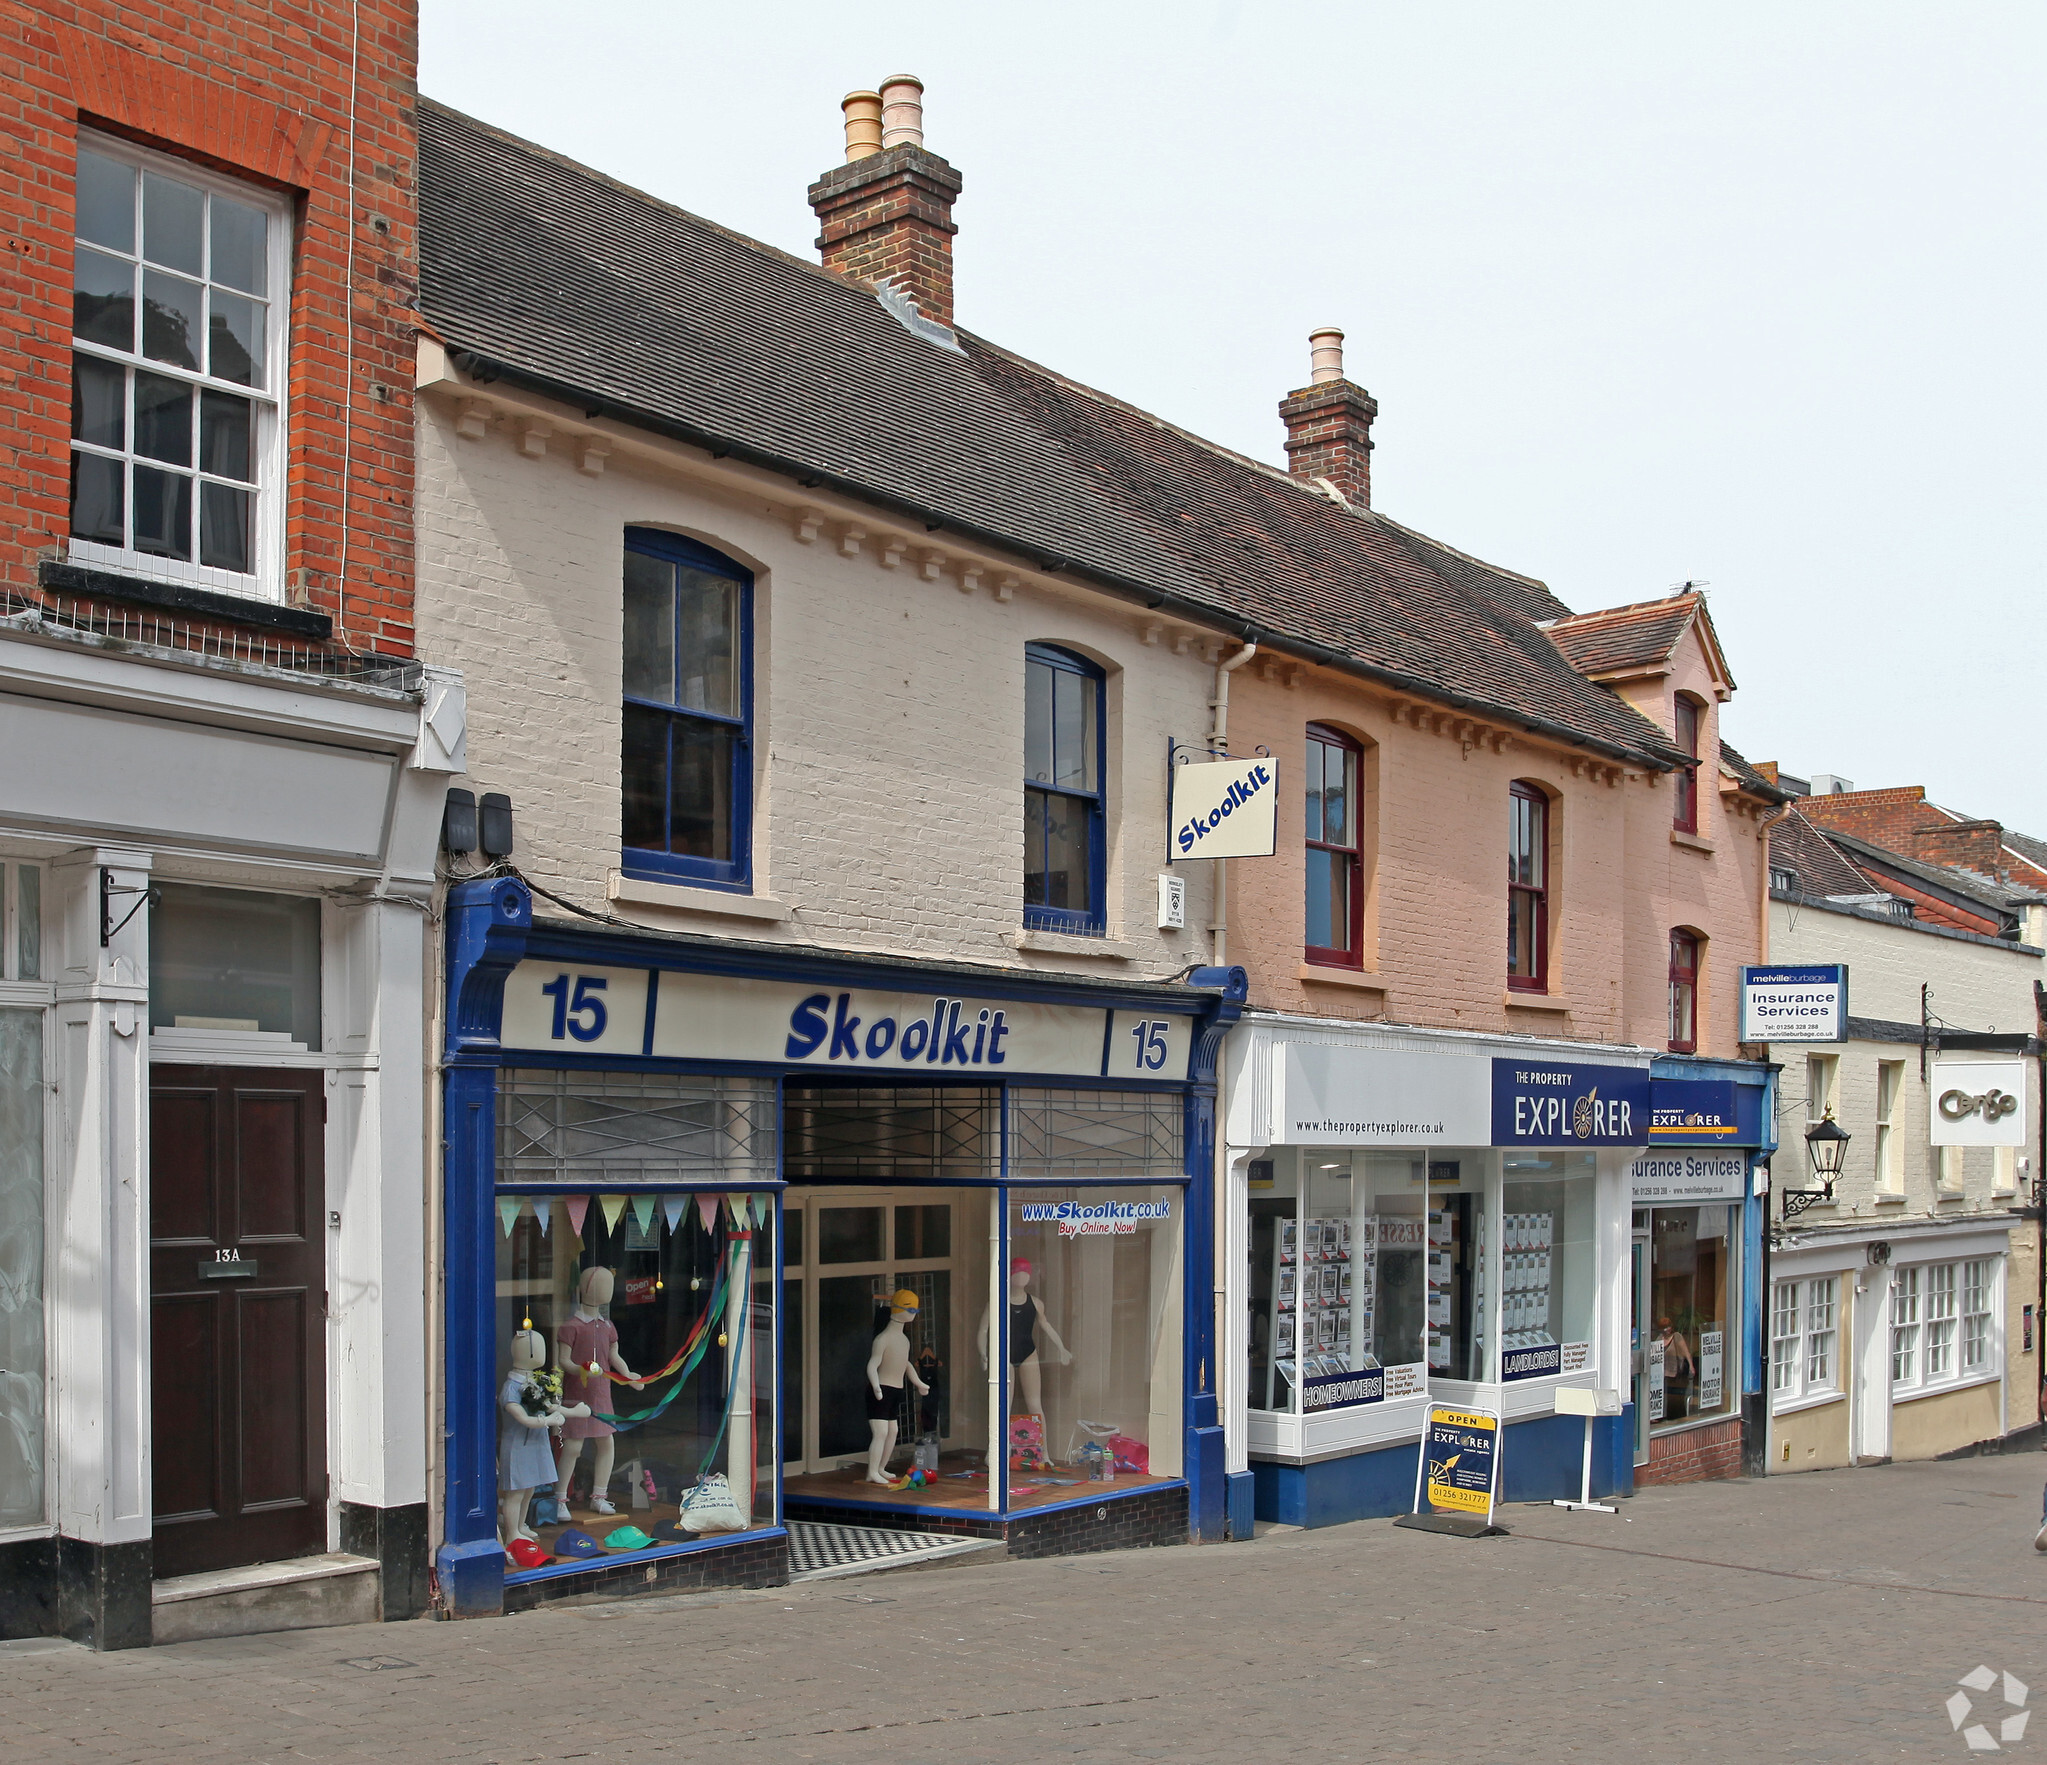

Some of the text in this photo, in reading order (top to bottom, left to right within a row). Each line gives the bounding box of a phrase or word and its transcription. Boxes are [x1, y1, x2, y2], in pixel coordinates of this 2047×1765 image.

[1178, 765, 1271, 853] Skoolkit
[1752, 974, 1827, 983] melvilleburbage
[1752, 993, 1835, 1003] Insurance
[542, 973, 608, 1042] 15
[1757, 1006, 1829, 1016] Services
[785, 992, 1009, 1065] Skoolkit
[1131, 1020, 1169, 1071] 15
[1515, 1071, 1572, 1086] THE PROPERTY
[1515, 1092, 1633, 1139] EXPLORER
[1652, 1113, 1721, 1126] EXPLORER
[1296, 1118, 1444, 1136] www.thepropertyexplorer.co.uk
[1686, 1156, 1740, 1177] Services
[1022, 1196, 1169, 1219] www.Skoolkit.co.uk
[1059, 1220, 1137, 1236] Buy Online Now!
[215, 1248, 241, 1262] 13A
[626, 1280, 649, 1292] Open
[1702, 1334, 1721, 1345] MELVILLE
[1504, 1350, 1559, 1374] LANDLORDS!
[1702, 1378, 1720, 1389] MOTOR
[1303, 1377, 1383, 1407] HOMEOWNERS!
[1448, 1415, 1477, 1425] OPEN
[1434, 1432, 1490, 1449] EXPLORER
[1433, 1488, 1486, 1503] 01256 321777
